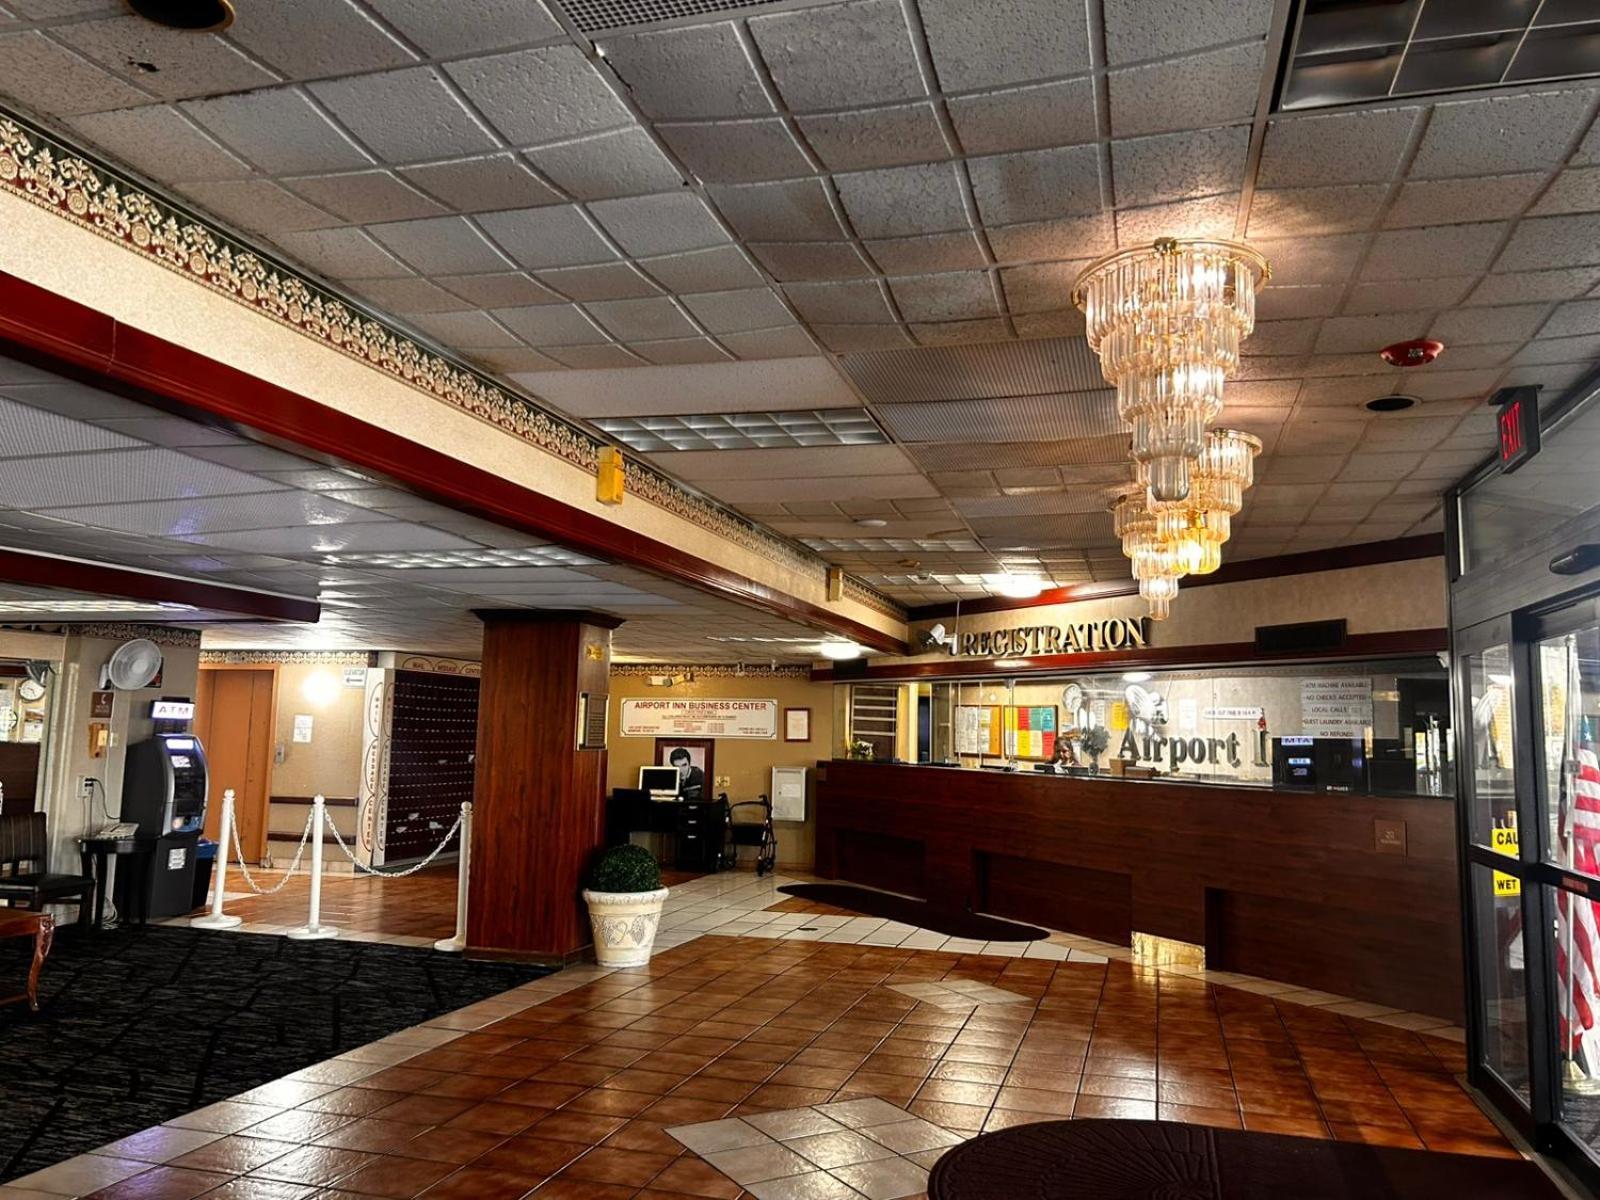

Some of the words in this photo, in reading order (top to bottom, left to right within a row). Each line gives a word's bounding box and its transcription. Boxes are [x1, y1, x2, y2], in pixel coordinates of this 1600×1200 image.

[1501, 401, 1521, 461] EXIT
[960, 616, 1147, 657] REGISTRATION
[159, 706, 189, 714] ATM
[634, 701, 670, 709] AIRPORT
[672, 701, 687, 709] INN
[688, 701, 730, 710] BUSINESS
[732, 702, 767, 711] CENTER
[1118, 722, 1241, 772] Airport
[1496, 880, 1517, 890] WET
